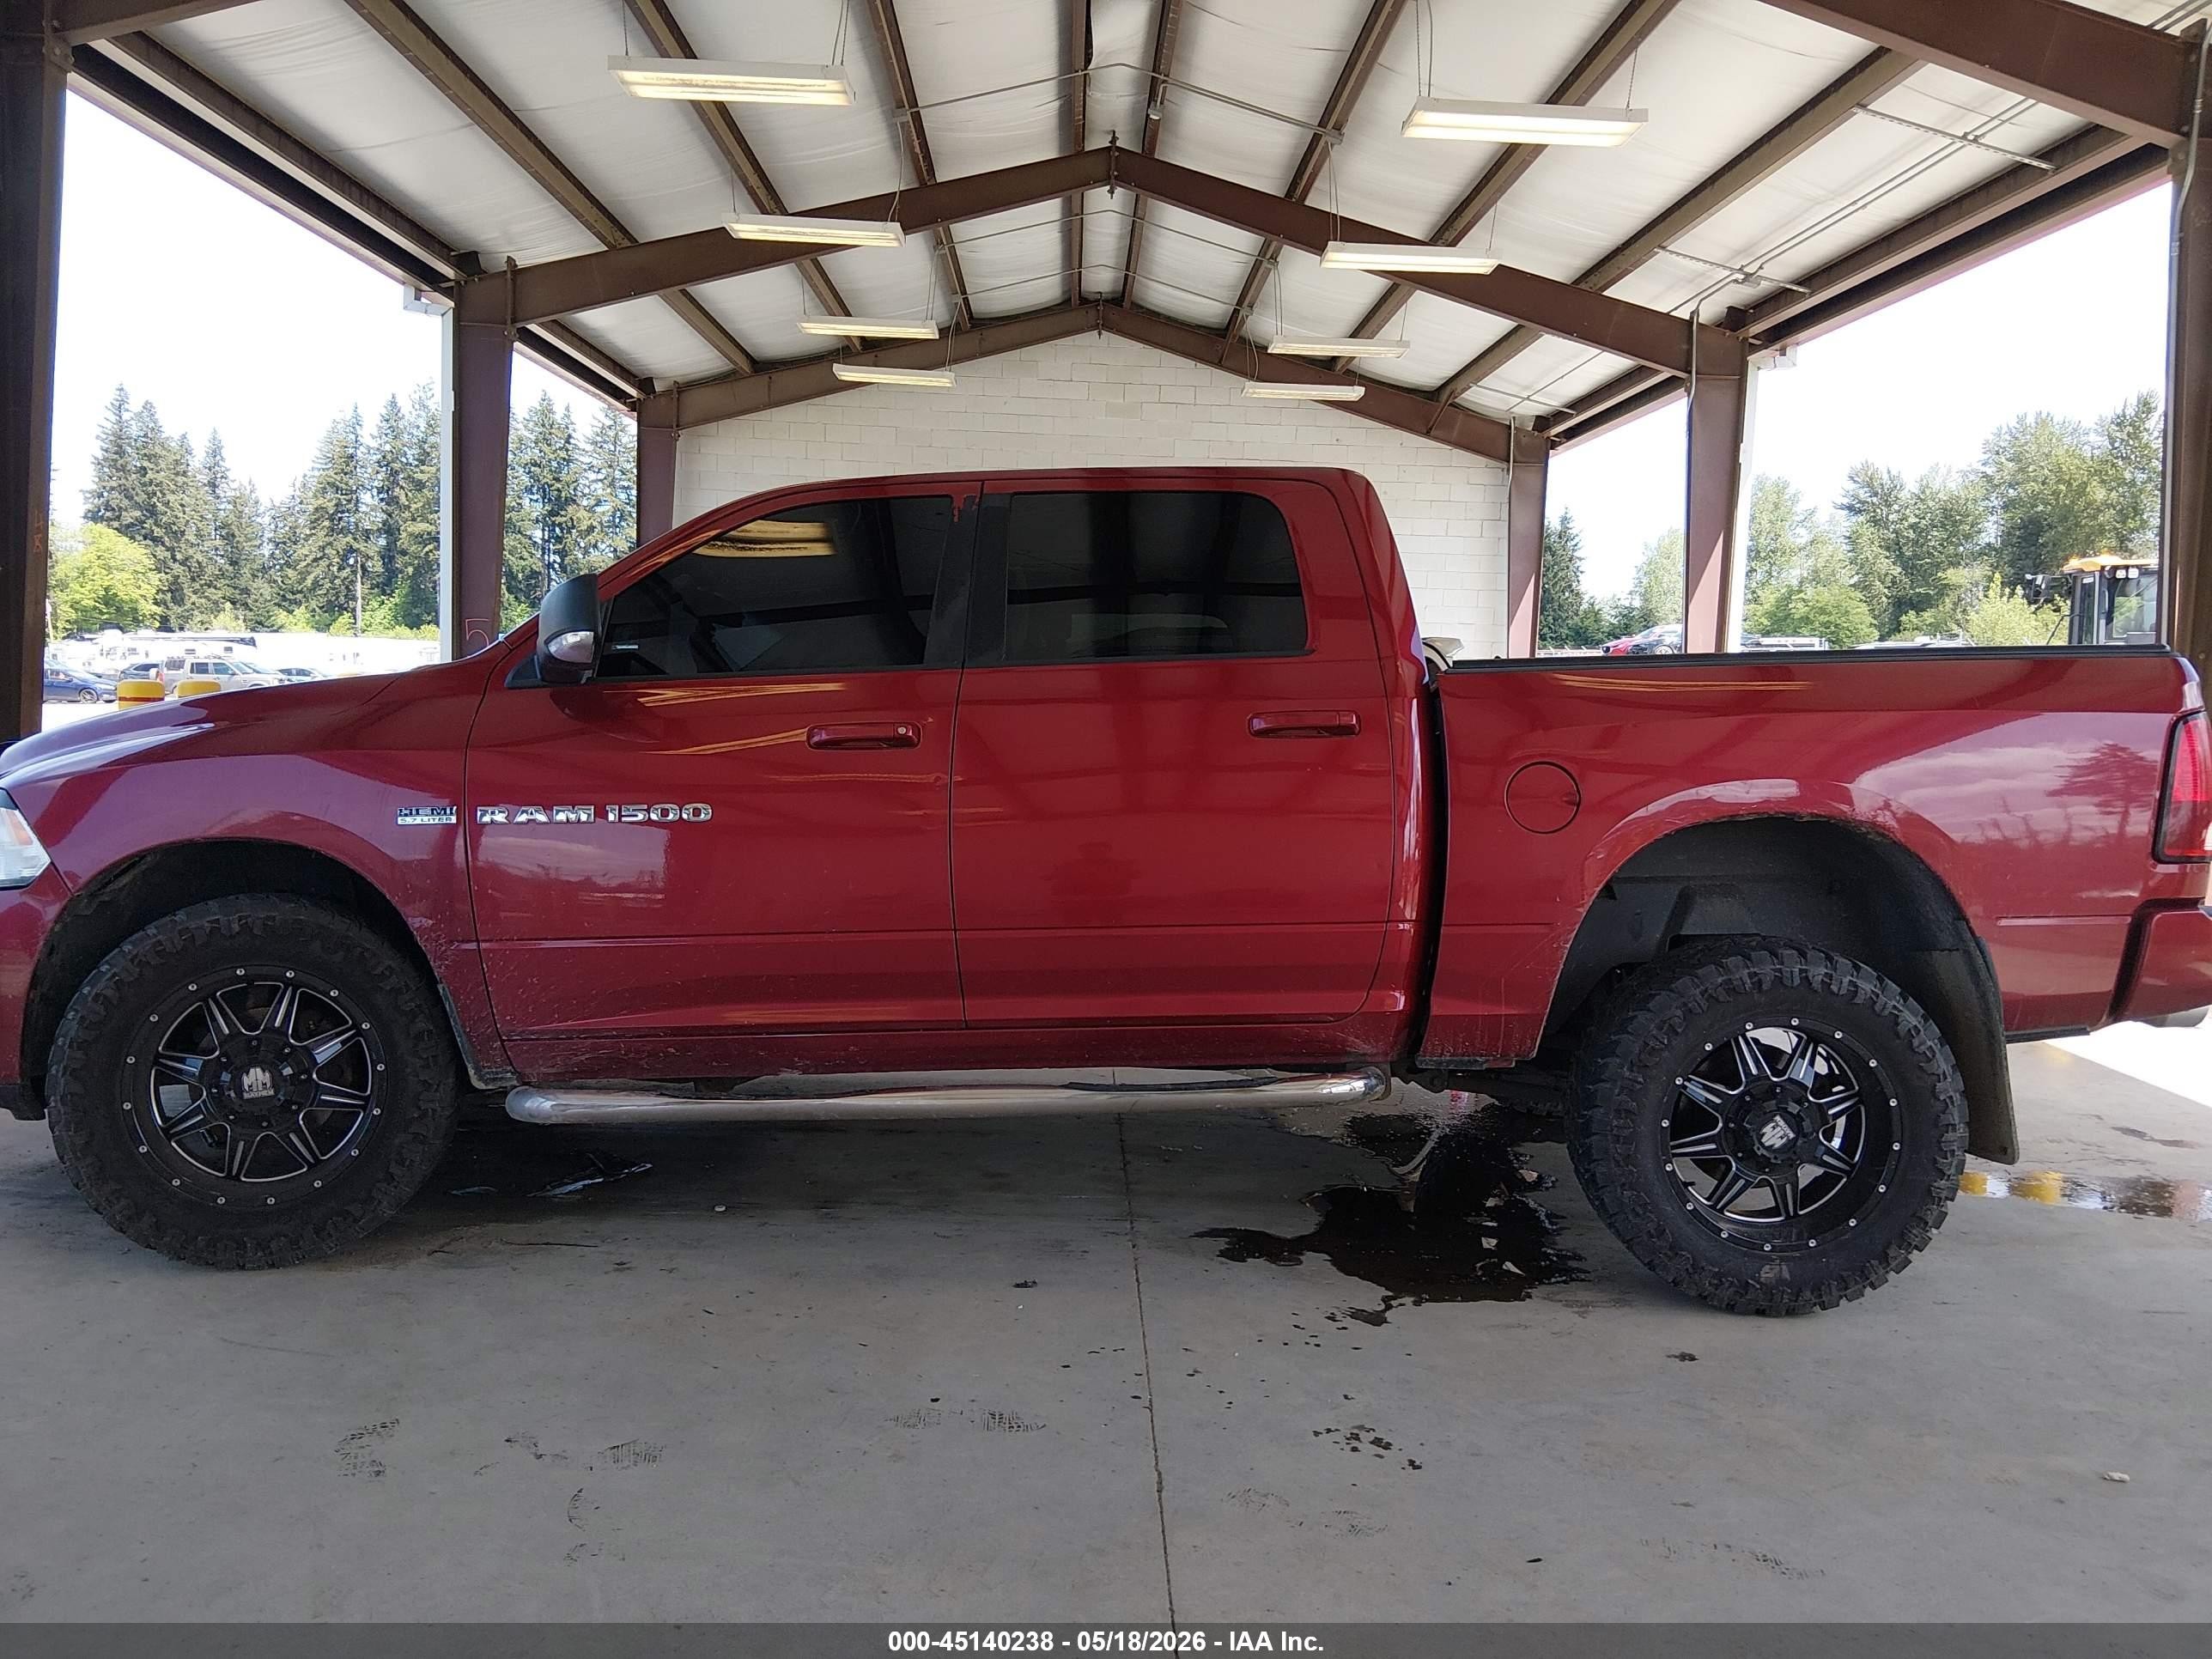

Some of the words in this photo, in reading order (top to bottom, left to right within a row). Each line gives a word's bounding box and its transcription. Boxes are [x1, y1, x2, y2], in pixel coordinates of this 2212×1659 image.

[398, 806, 457, 817] HEMI
[477, 805, 596, 824] RAM
[605, 803, 713, 823] 1500
